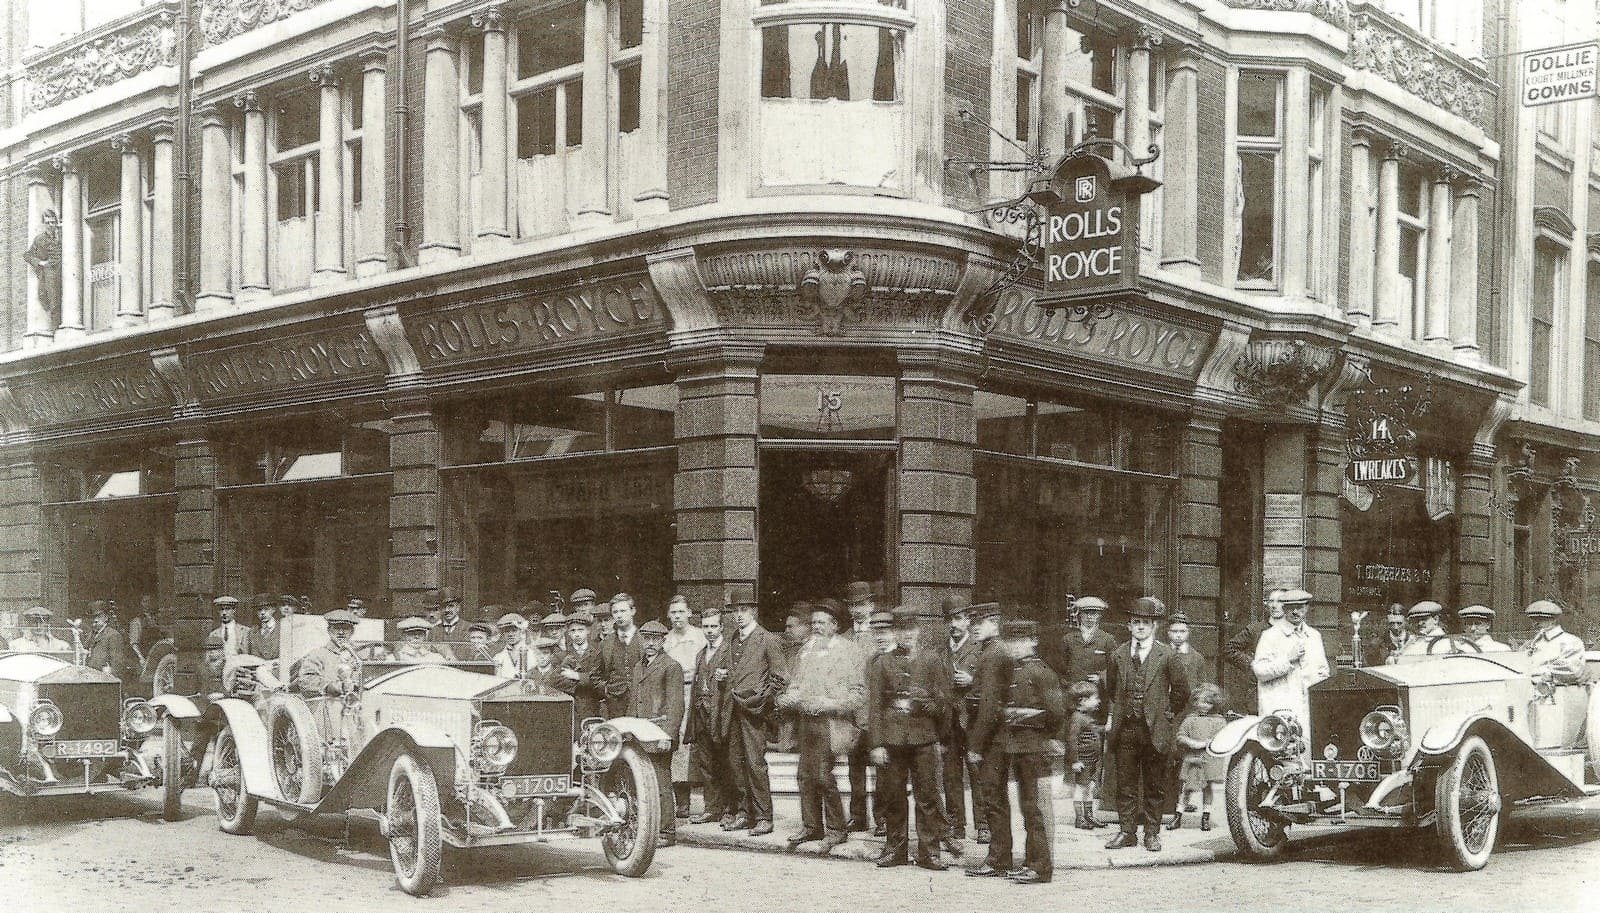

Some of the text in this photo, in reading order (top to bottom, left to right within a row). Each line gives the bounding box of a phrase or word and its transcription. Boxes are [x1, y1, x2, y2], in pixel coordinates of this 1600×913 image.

[1049, 206, 1121, 243] ROLLS
[1049, 246, 1122, 282] ROYCE
[818, 390, 842, 411] 15
[1372, 419, 1388, 440] 14
[1315, 763, 1378, 779] R-1706
[502, 778, 567, 795] -1705
